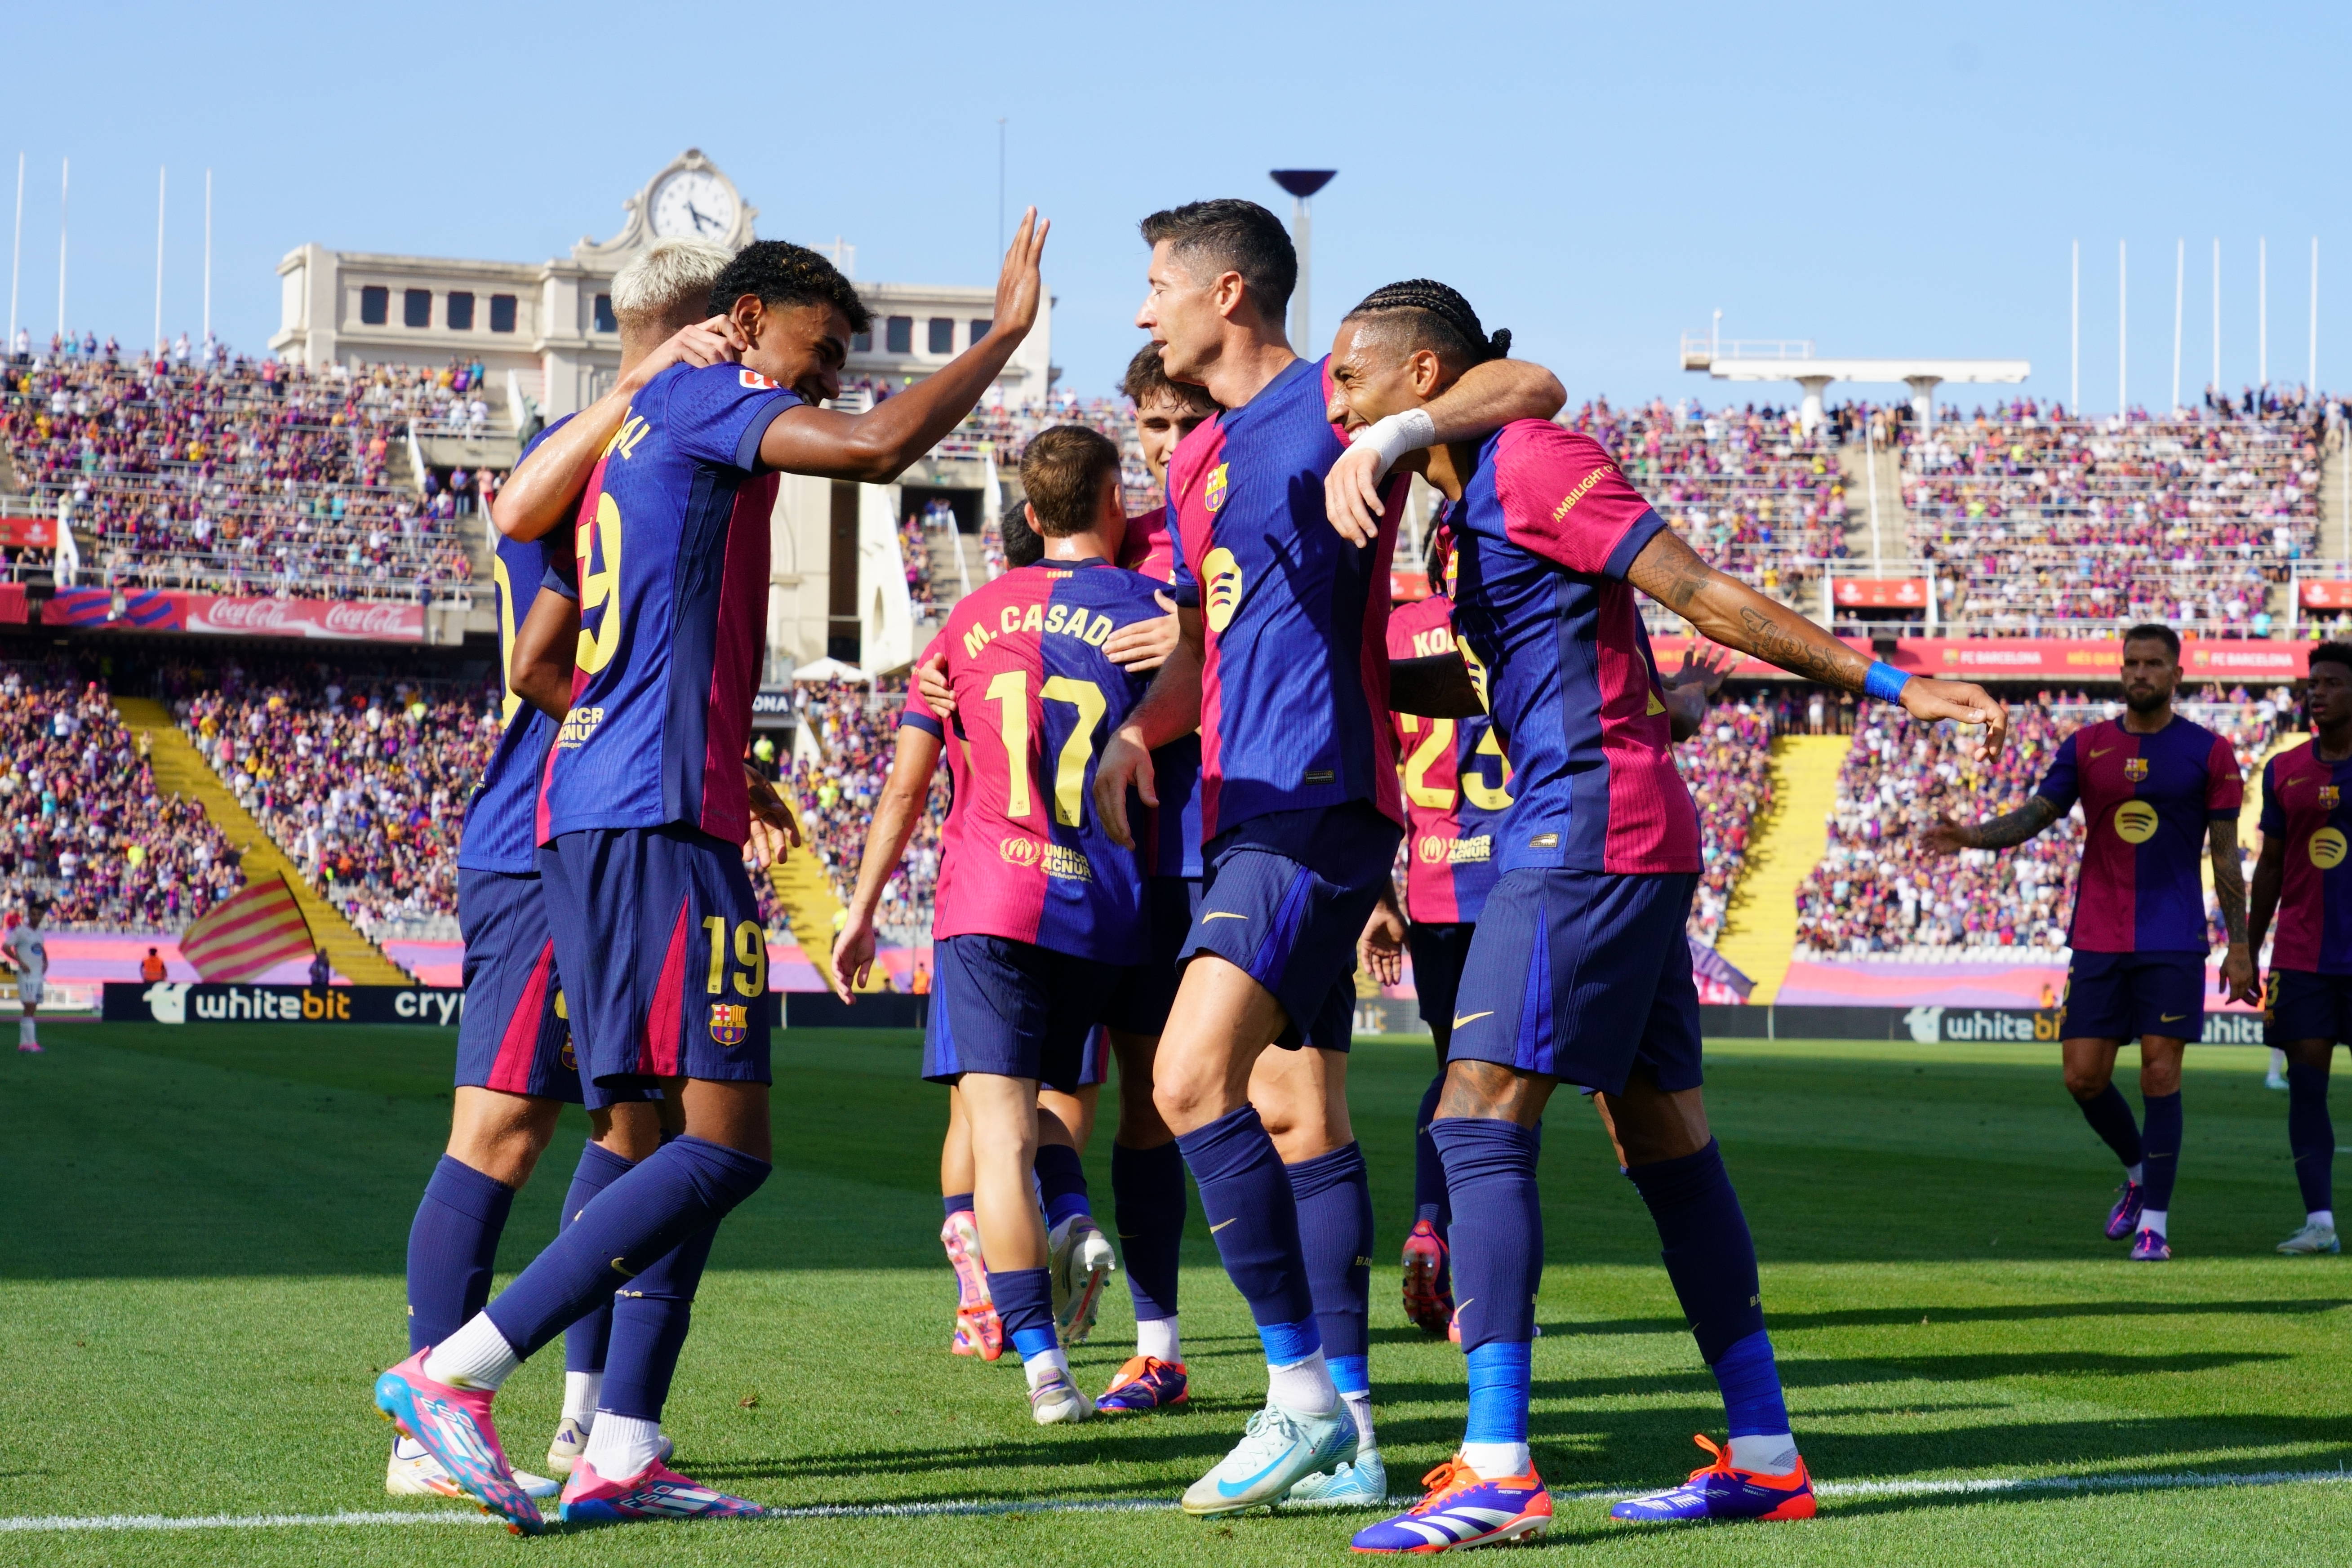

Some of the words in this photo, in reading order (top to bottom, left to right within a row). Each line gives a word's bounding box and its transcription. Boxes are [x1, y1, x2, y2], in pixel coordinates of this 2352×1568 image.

[1553, 468, 1605, 523] AMBILIGHT
[1603, 464, 1614, 473] tv
[963, 622, 997, 659] M.
[1976, 651, 2042, 665] BARCELONA
[2211, 652, 2225, 666] FC
[2227, 652, 2294, 667] BARCELONA
[984, 670, 1107, 827] 17
[1040, 857, 1092, 878] ACNUR
[1044, 843, 1089, 866] UNHCR
[702, 915, 766, 997] 19
[196, 988, 351, 1020] whitebit
